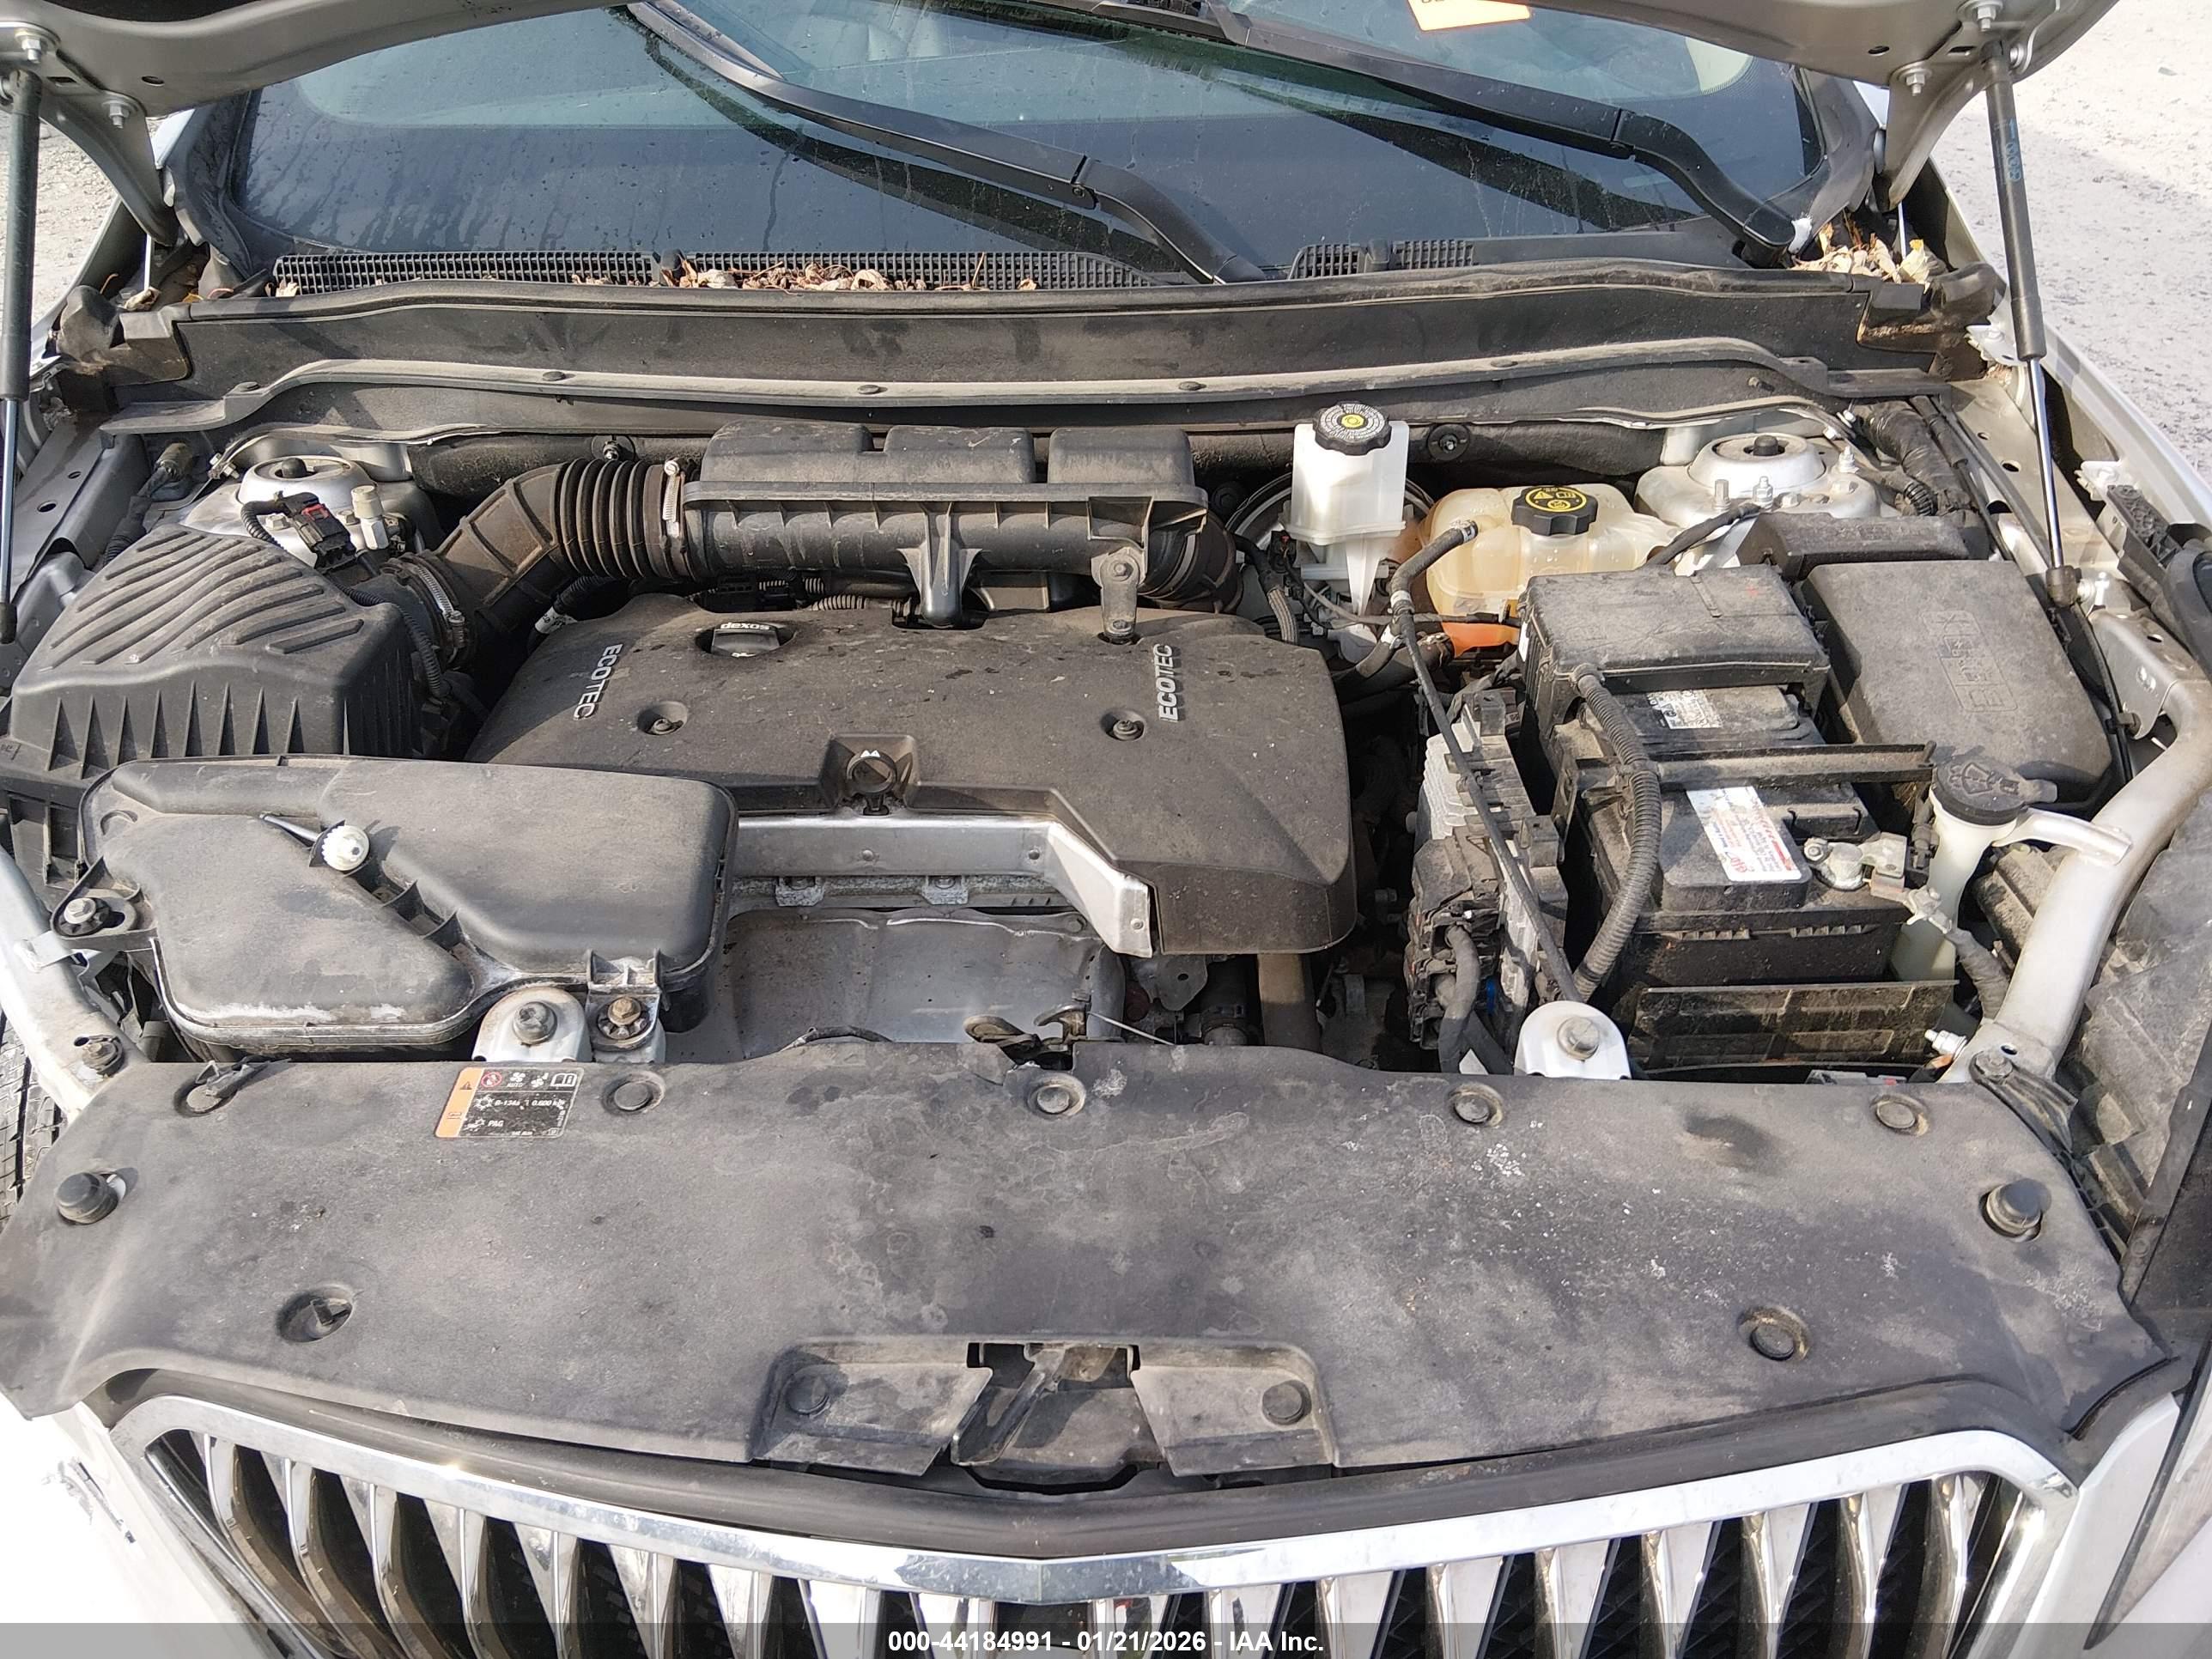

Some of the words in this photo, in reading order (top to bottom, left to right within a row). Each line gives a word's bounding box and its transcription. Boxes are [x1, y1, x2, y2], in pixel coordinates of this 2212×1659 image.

[720, 622, 770, 630] dexos
[573, 643, 623, 720] ECOTEC
[1152, 643, 1179, 721] ECOTEC
